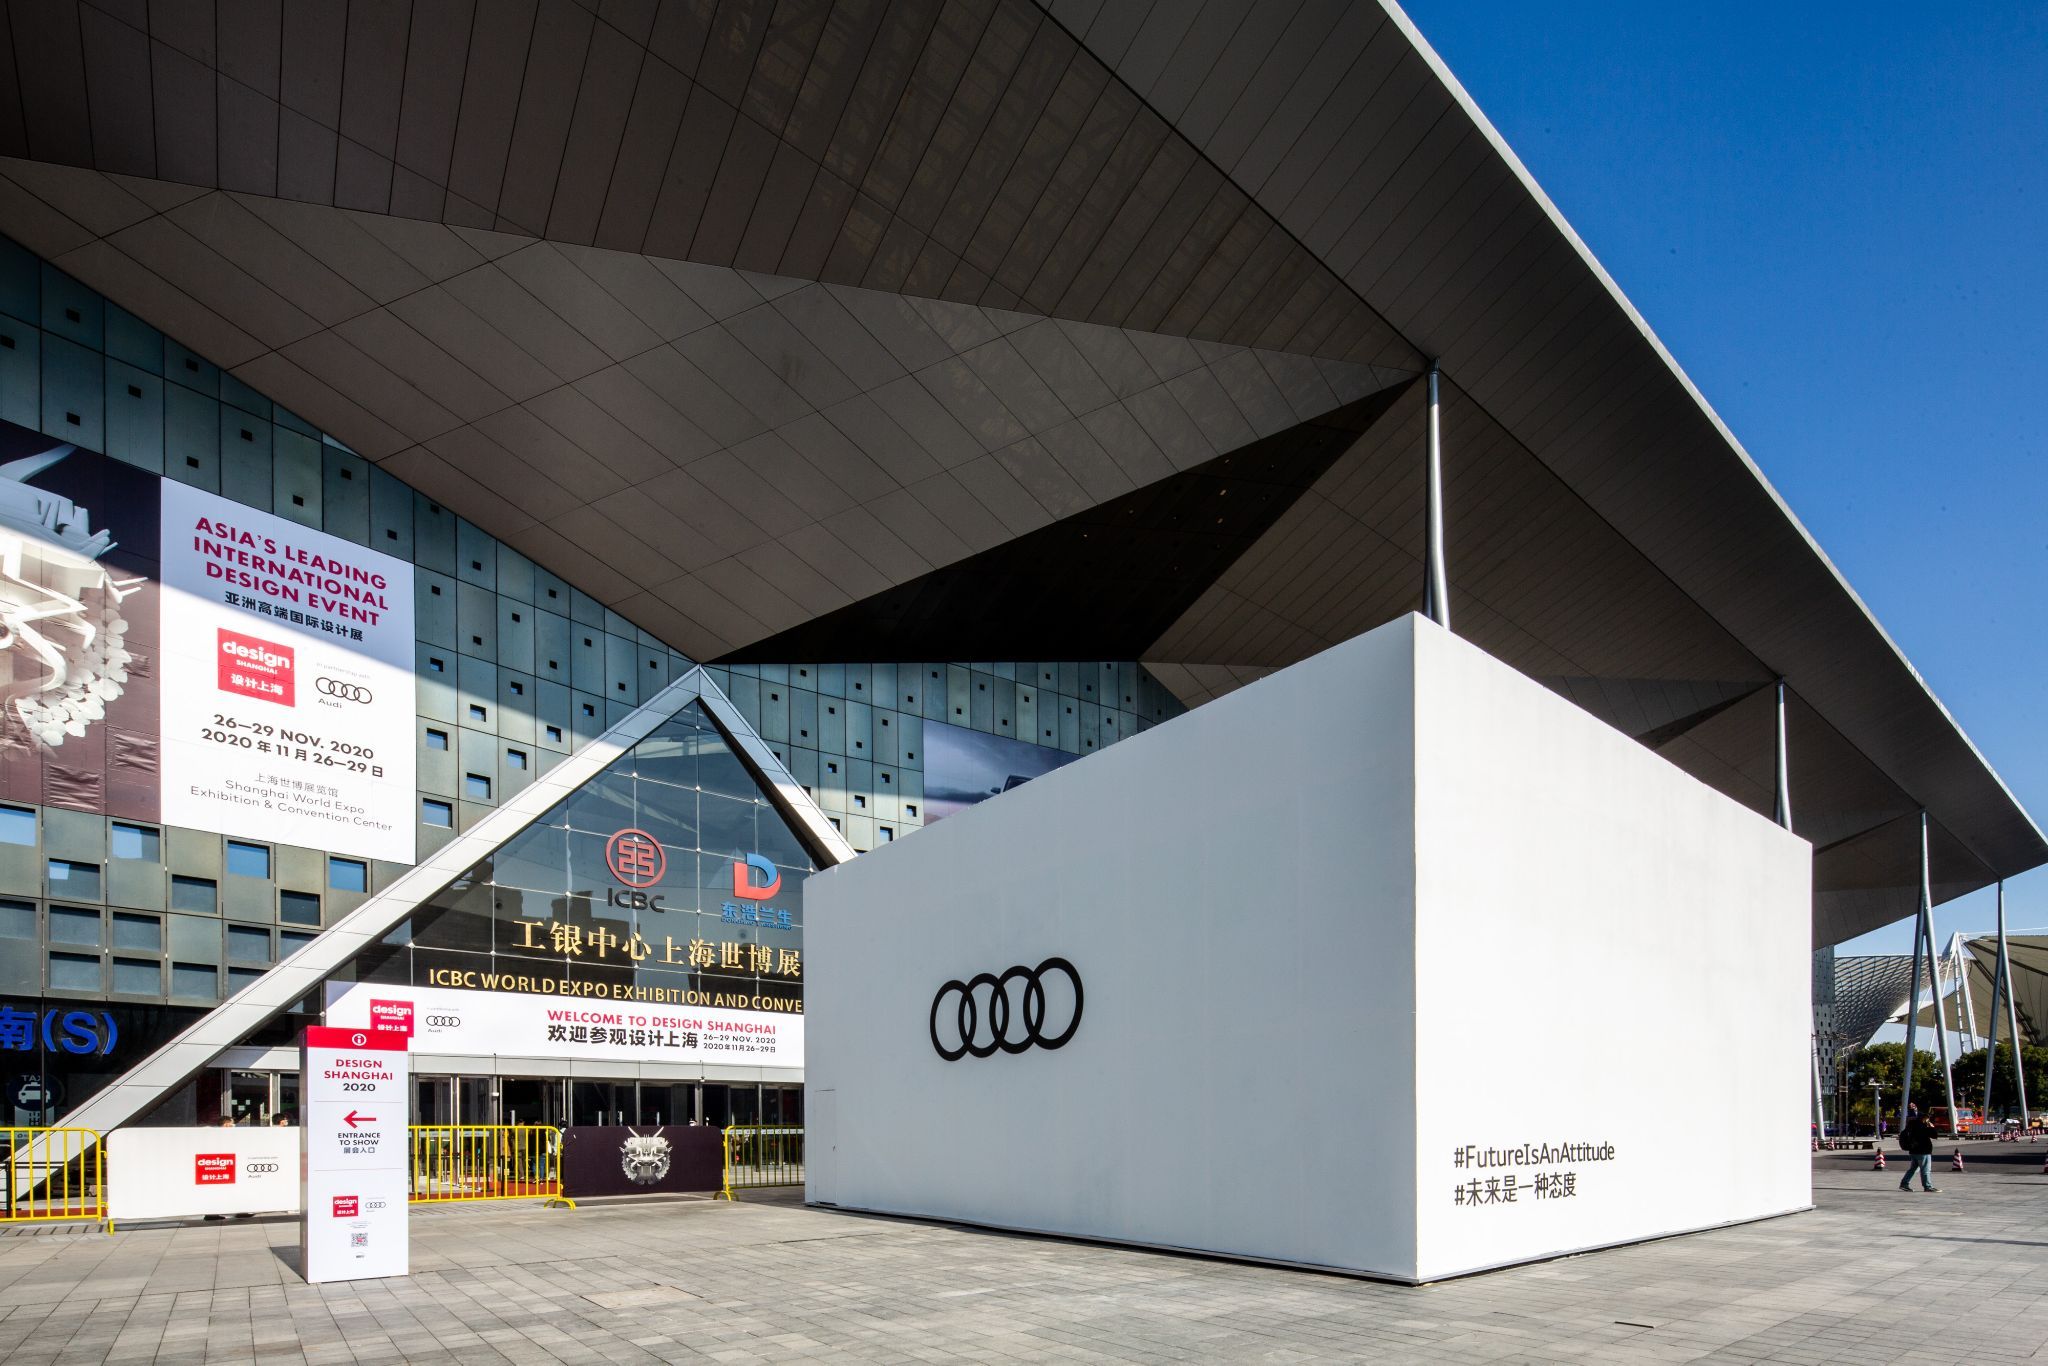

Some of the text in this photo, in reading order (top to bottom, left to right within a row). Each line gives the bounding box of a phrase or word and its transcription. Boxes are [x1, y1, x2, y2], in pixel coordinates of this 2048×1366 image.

[194, 536, 389, 610] INTERNATIONAL
[285, 545, 387, 590] LEADING
[206, 561, 380, 626] DESIGN EVENT
[225, 591, 363, 642] 亚洲高端国际设计展
[222, 641, 291, 669] design
[236, 659, 278, 675] SHANGHAI
[230, 673, 284, 696] 设计上海
[318, 698, 342, 709] Audi
[201, 728, 252, 749] 2020
[280, 728, 324, 749] NOV.
[330, 740, 374, 760] 2020
[225, 779, 365, 816] Shanghai World Expo
[255, 772, 338, 798] 上海世博展览馆
[190, 786, 393, 832] Exhibition & Convention Center
[607, 888, 665, 914] ICBC
[720, 901, 792, 926] 东浩兰生
[512, 920, 801, 977] 工银中心上海世博展
[429, 968, 803, 1013] ICBC WORLD EXPO EXHIBITION AND CONVE
[372, 1004, 412, 1016] design
[547, 1010, 776, 1035] WELCOME TO DESIGN SHANGHAI
[547, 1025, 698, 1049] 欢迎参观设计上海
[732, 1035, 752, 1043] NOV.
[324, 1070, 393, 1080] SHANGHAI
[336, 1059, 382, 1068] DESIGN
[343, 1083, 376, 1092] 2020
[198, 1157, 234, 1166] design
[1454, 1141, 1615, 1169] #FutureIsAnAttitude
[1454, 1172, 1576, 1207] #未来是一种态度
